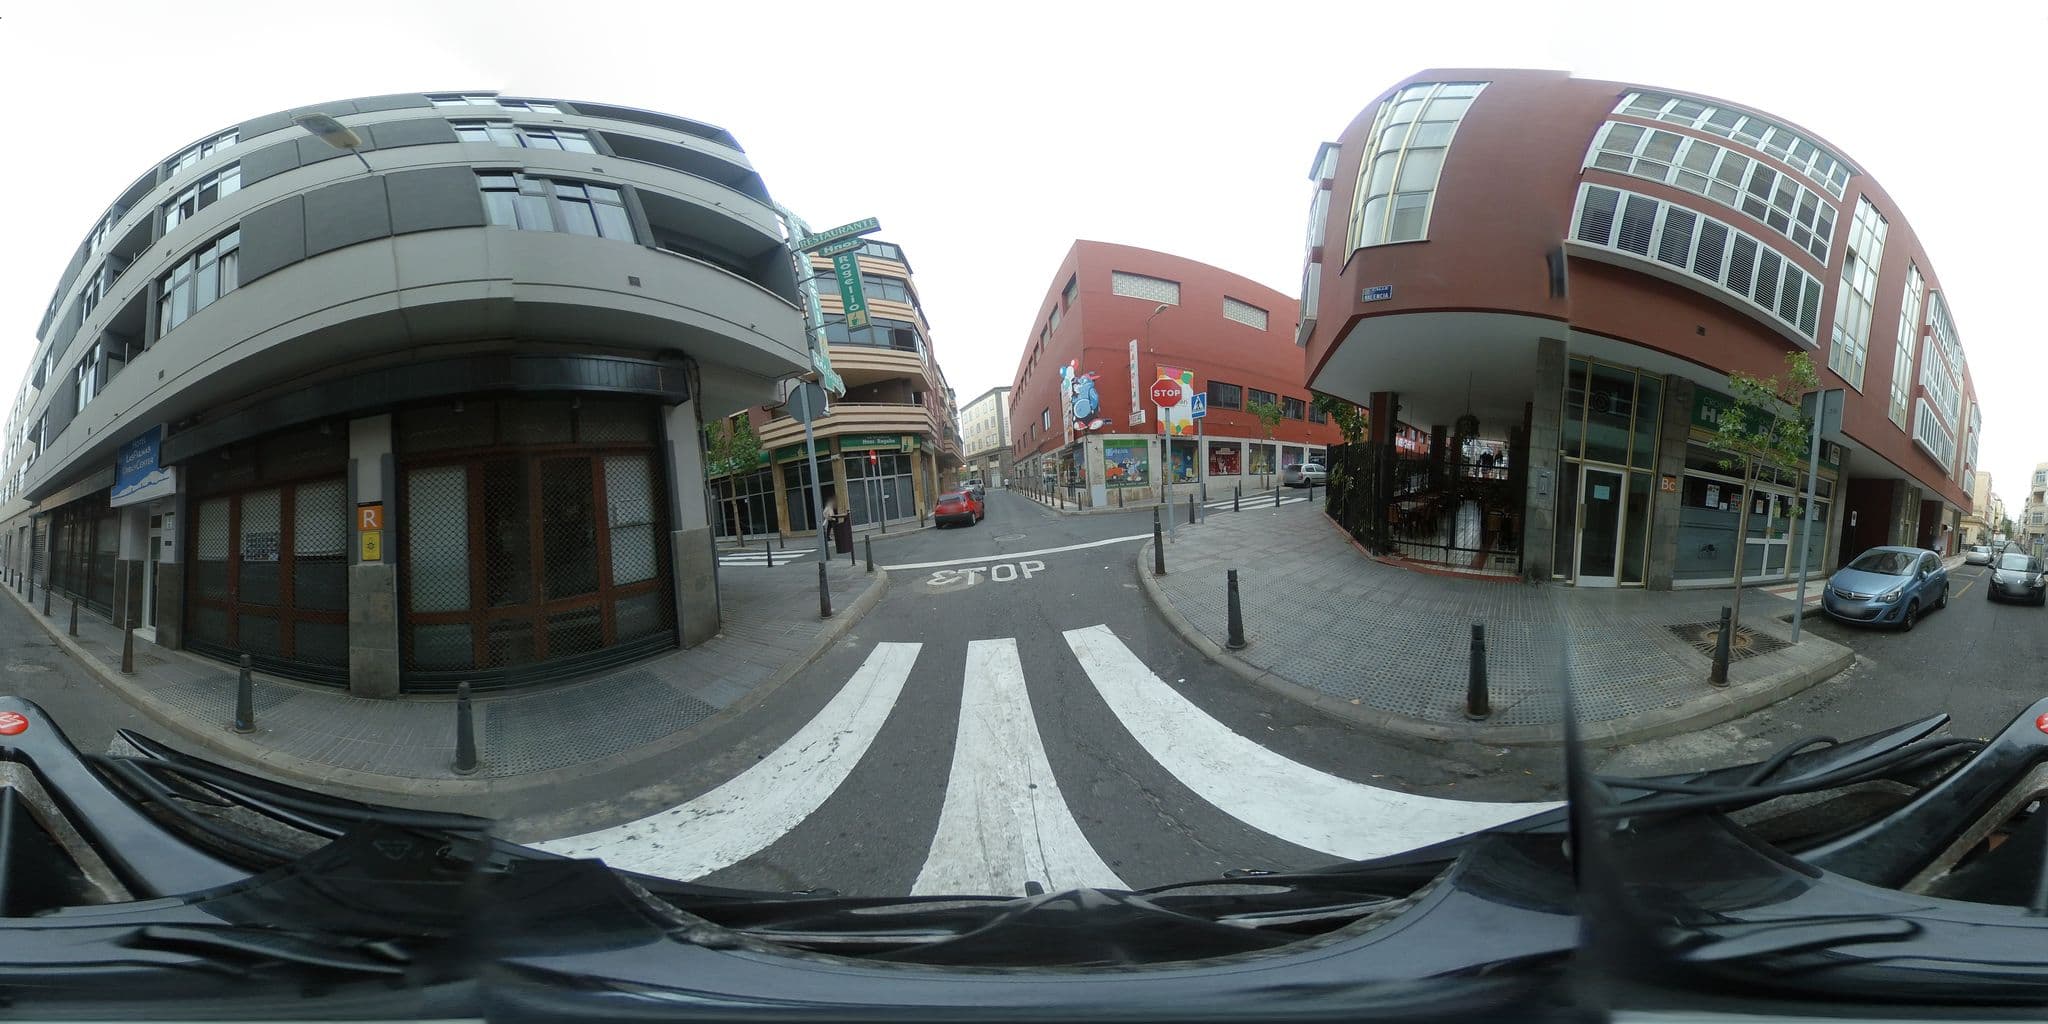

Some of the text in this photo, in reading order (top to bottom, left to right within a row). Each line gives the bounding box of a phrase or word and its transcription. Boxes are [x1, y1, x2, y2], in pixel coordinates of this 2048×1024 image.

[800, 219, 879, 248] RESTAURANTE
[1154, 389, 1181, 397] STOP
[1662, 478, 1675, 491] Bc
[364, 510, 377, 528] R
[927, 560, 1045, 585] STOP
